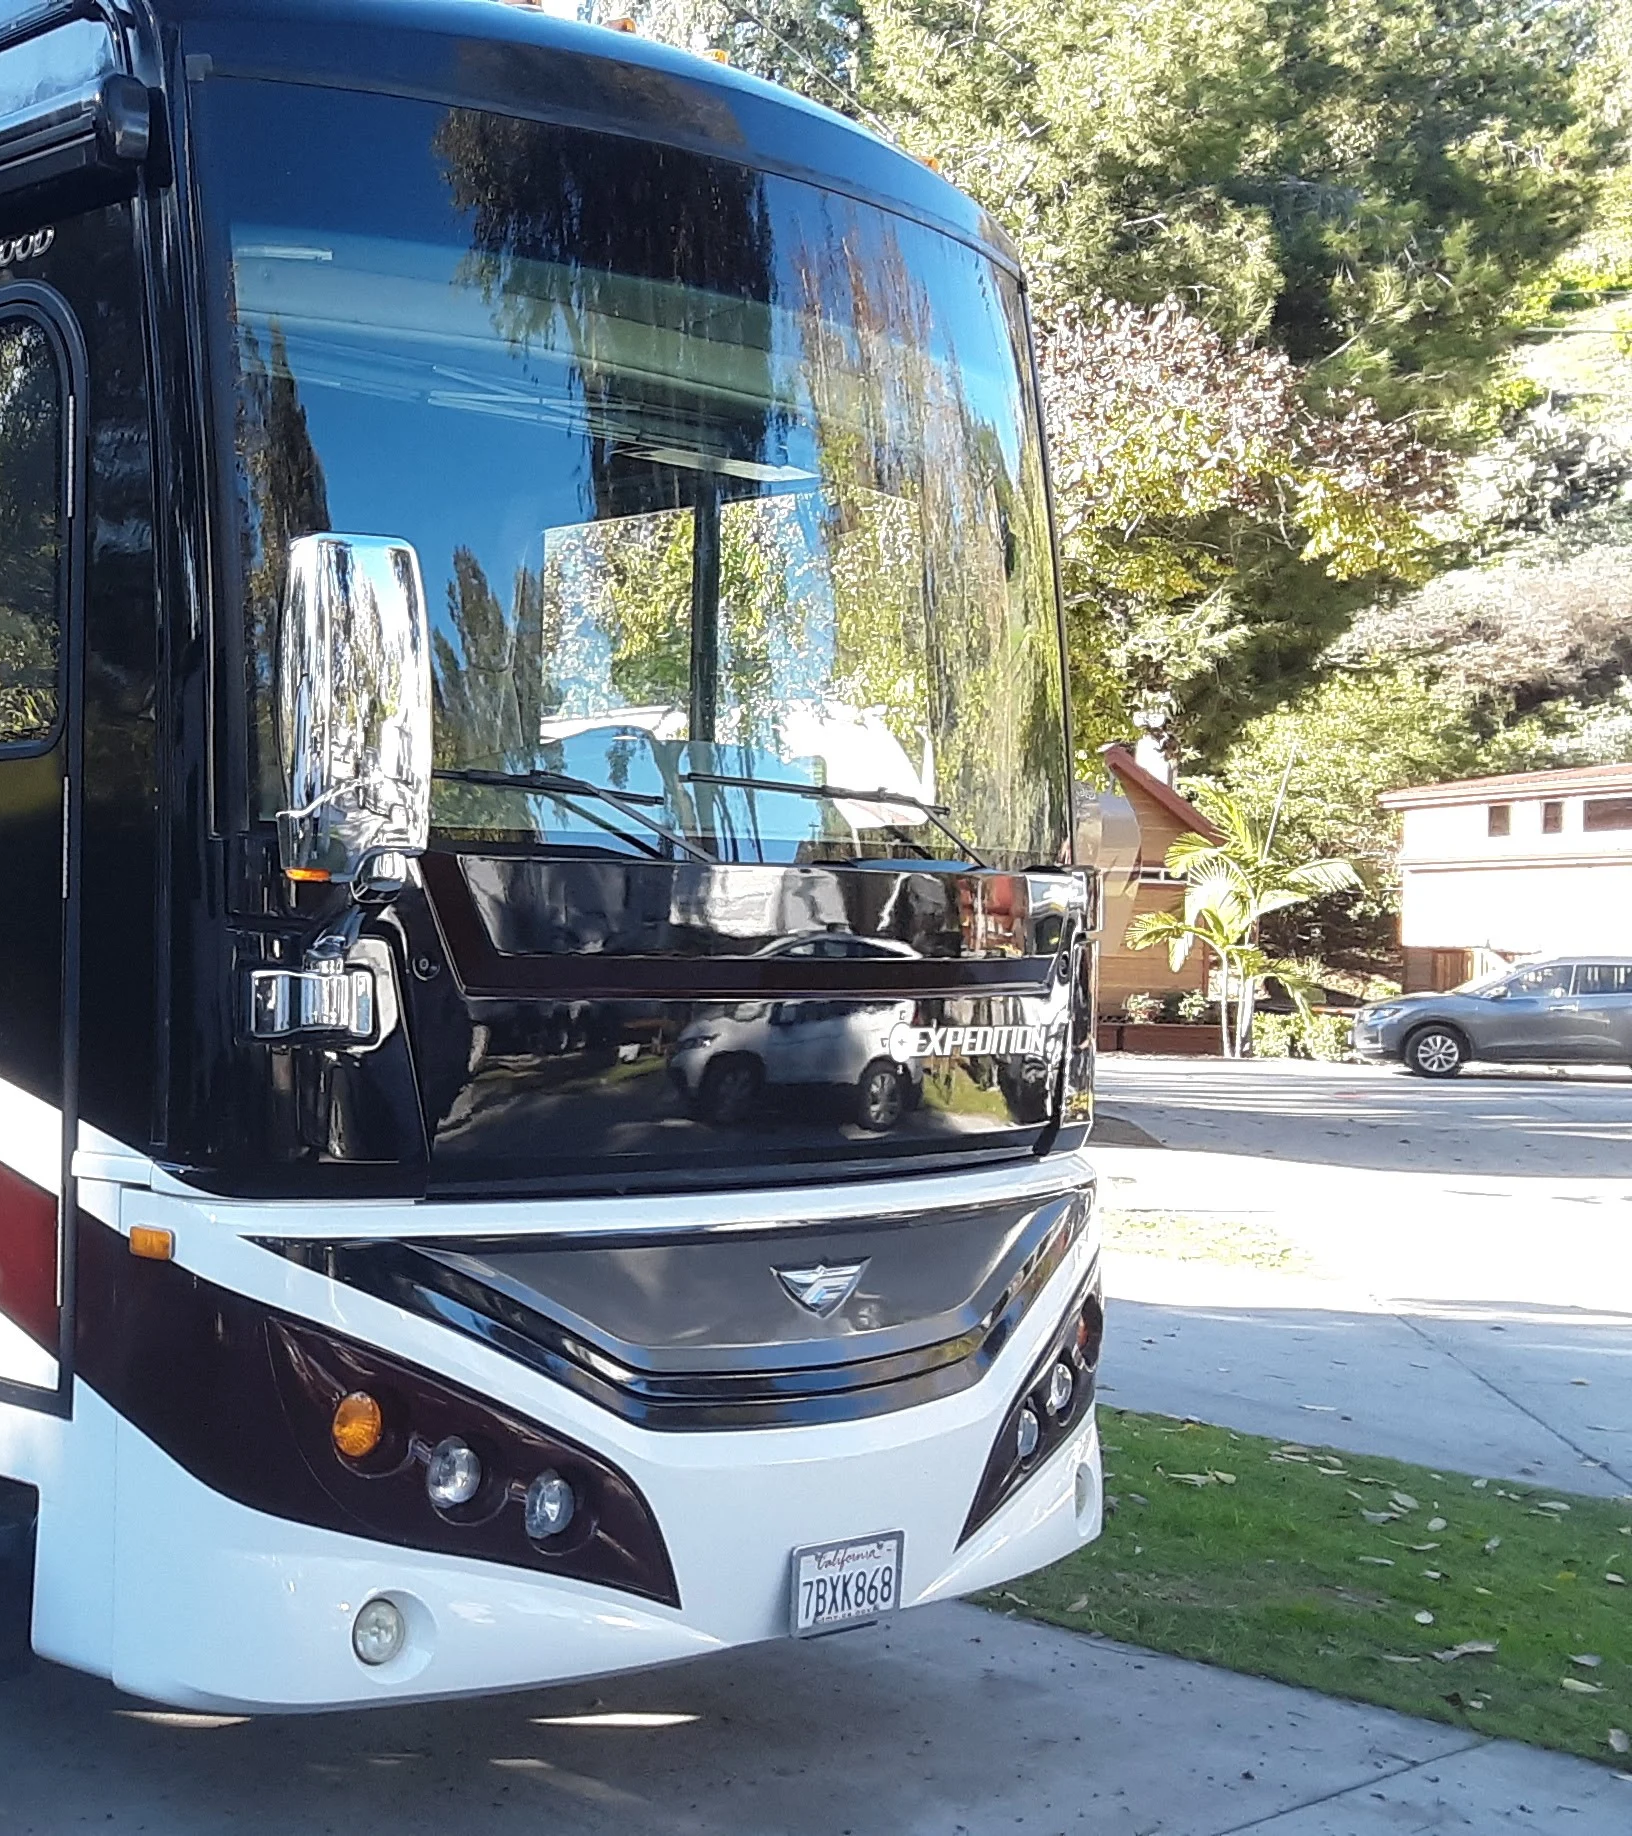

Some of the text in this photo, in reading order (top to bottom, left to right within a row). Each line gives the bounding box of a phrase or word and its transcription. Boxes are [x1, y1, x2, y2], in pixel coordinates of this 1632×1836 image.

[910, 1025, 1047, 1057] EXPEDITION
[816, 1548, 882, 1571] California
[802, 1565, 893, 1620] 7BXK868
